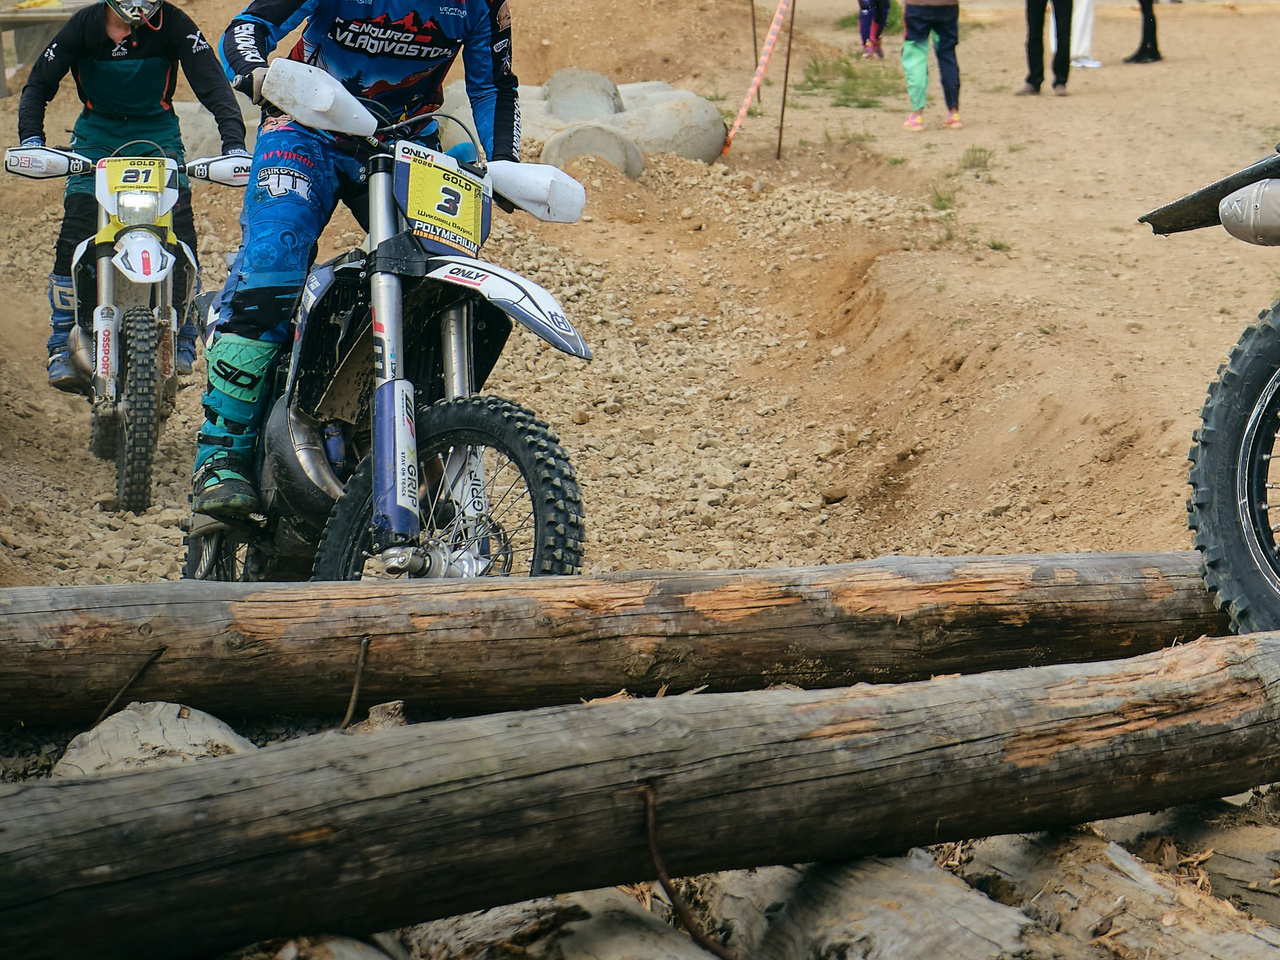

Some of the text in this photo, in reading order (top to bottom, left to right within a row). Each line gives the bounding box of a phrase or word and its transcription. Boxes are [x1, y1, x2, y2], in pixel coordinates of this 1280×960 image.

[233, 23, 264, 64] ENDURO
[349, 20, 415, 42] ENDURO
[401, 146, 434, 162] ONLY1
[122, 168, 152, 183] 21
[412, 157, 432, 168] 2026
[442, 172, 472, 192] GOLD
[435, 186, 463, 217] 3
[414, 220, 478, 252] POLYMERIUM
[417, 209, 473, 237] Шиковец Вадим
[448, 267, 489, 282] ONLY1
[103, 329, 111, 376] OSSPORT
